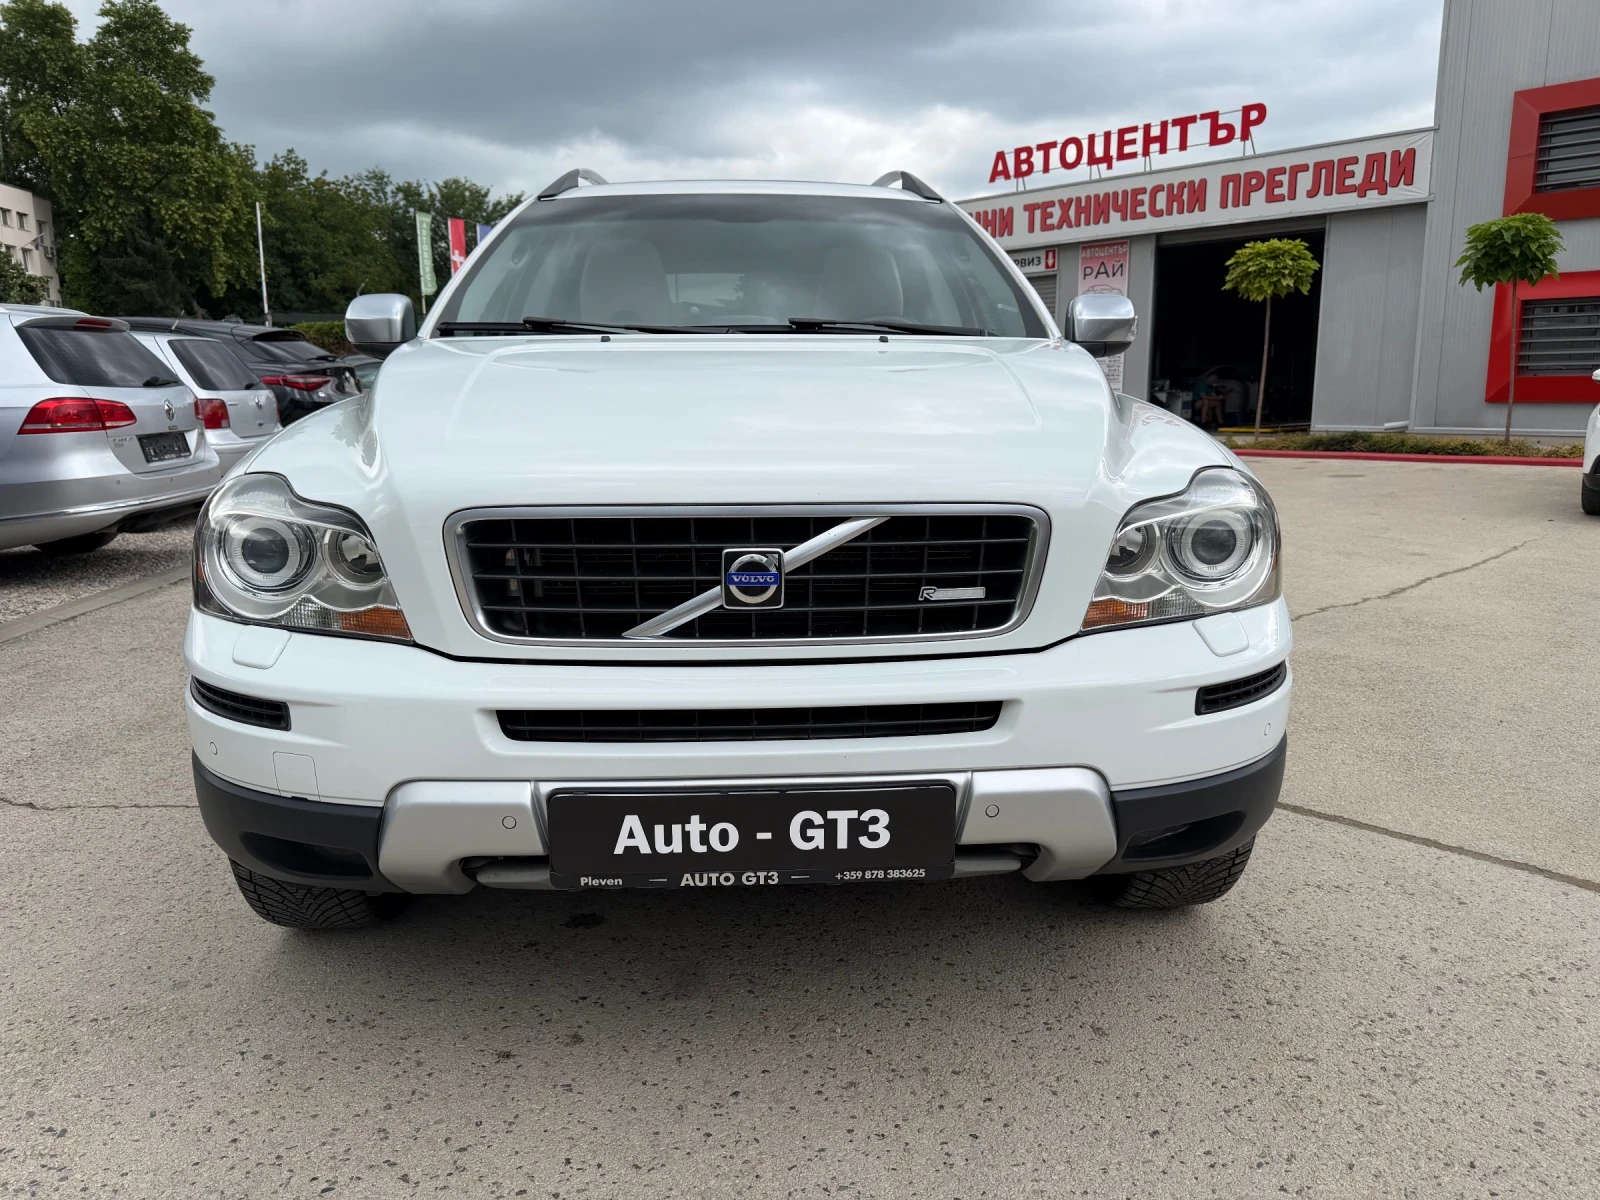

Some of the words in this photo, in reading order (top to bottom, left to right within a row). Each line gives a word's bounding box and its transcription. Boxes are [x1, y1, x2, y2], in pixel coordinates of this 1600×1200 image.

[988, 102, 1267, 184] АВТОЦЕНТЪР
[1023, 179, 1207, 234] ТЕХНИЧЕСКИ
[1219, 147, 1416, 210] ПРЕГЛЕДИ
[1081, 243, 1127, 257] АВТОЦЕНТЪР
[1083, 259, 1124, 280] РАЙ
[731, 574, 775, 583] VOLVO
[613, 814, 740, 855] Auto
[789, 808, 891, 851] GT3
[580, 876, 623, 886] Pleven
[680, 872, 735, 887] AUTO
[741, 871, 779, 885] GT3
[835, 870, 863, 880] +359
[864, 869, 885, 879] 878
[886, 868, 926, 878] 383625
